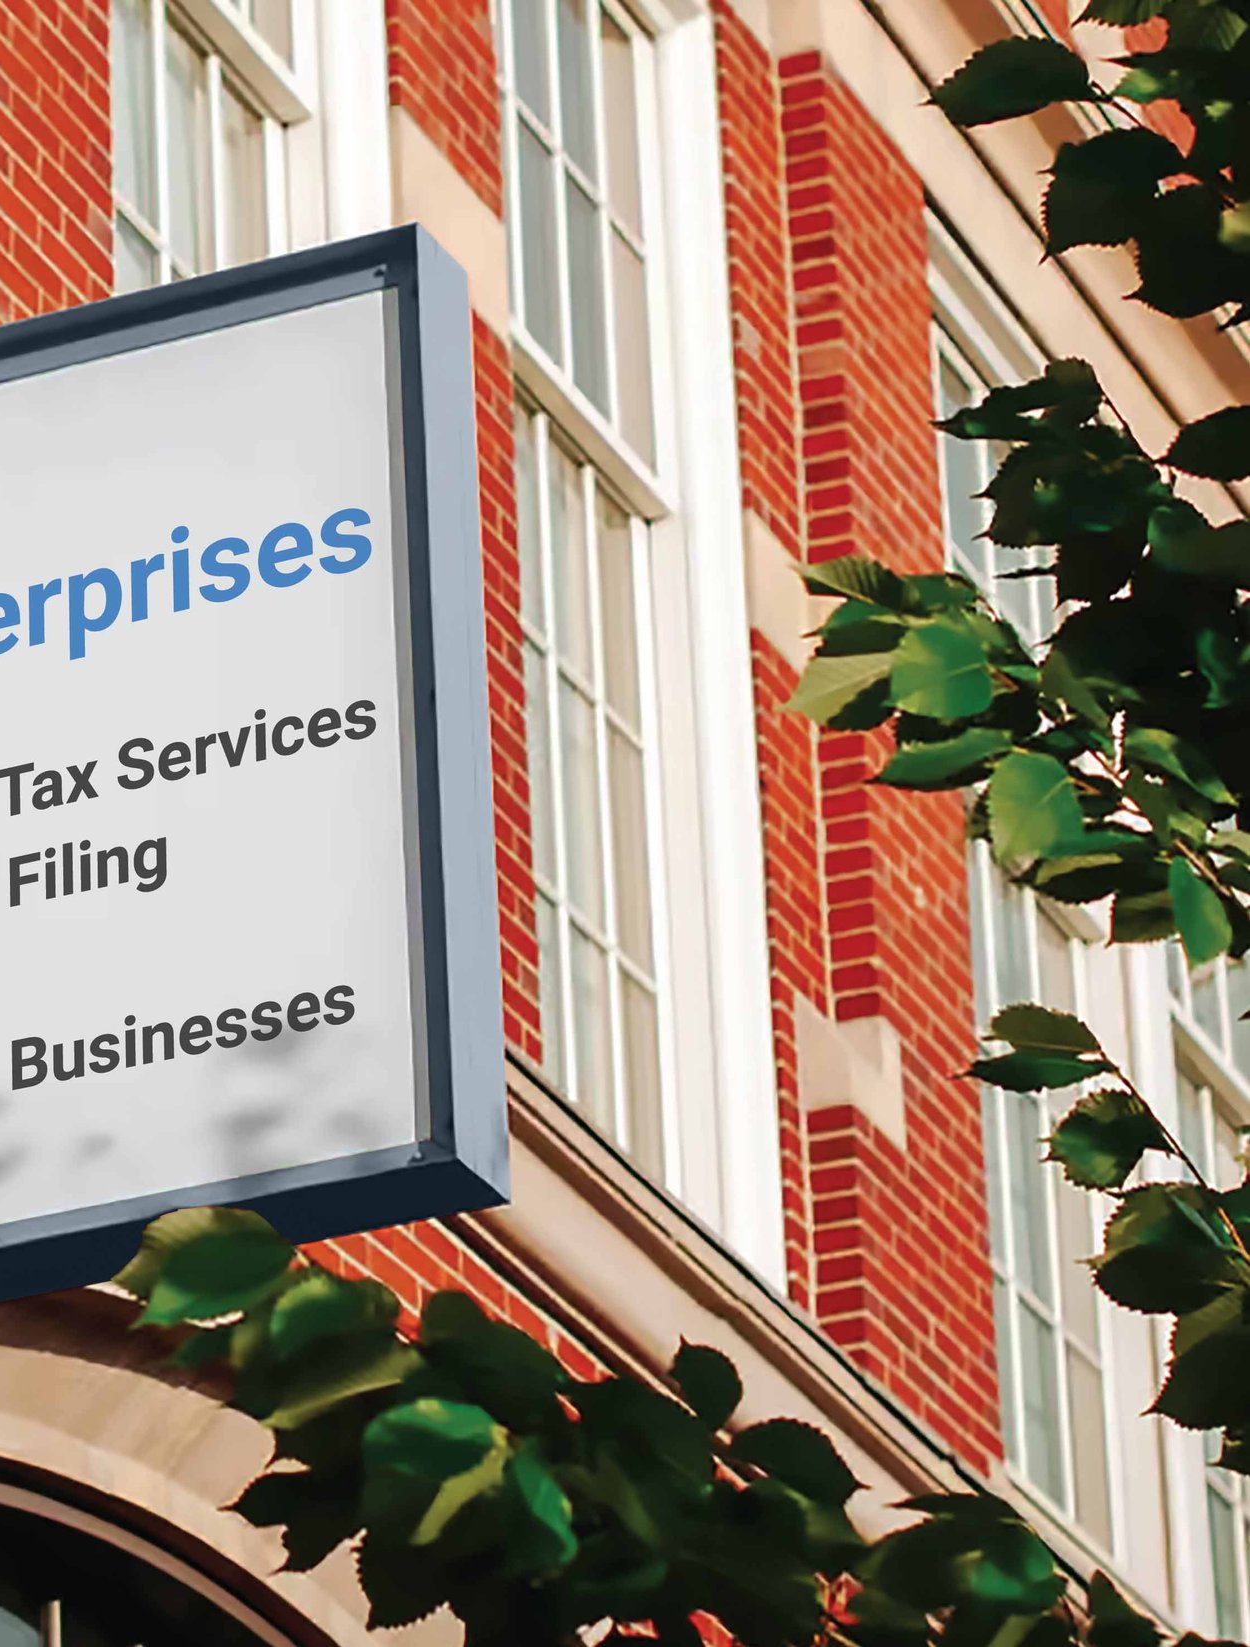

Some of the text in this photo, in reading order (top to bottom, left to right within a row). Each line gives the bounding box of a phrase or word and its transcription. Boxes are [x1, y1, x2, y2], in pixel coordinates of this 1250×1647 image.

[117, 699, 377, 790] Services
[9, 836, 167, 908] Filing
[11, 985, 355, 1091] Businesses
